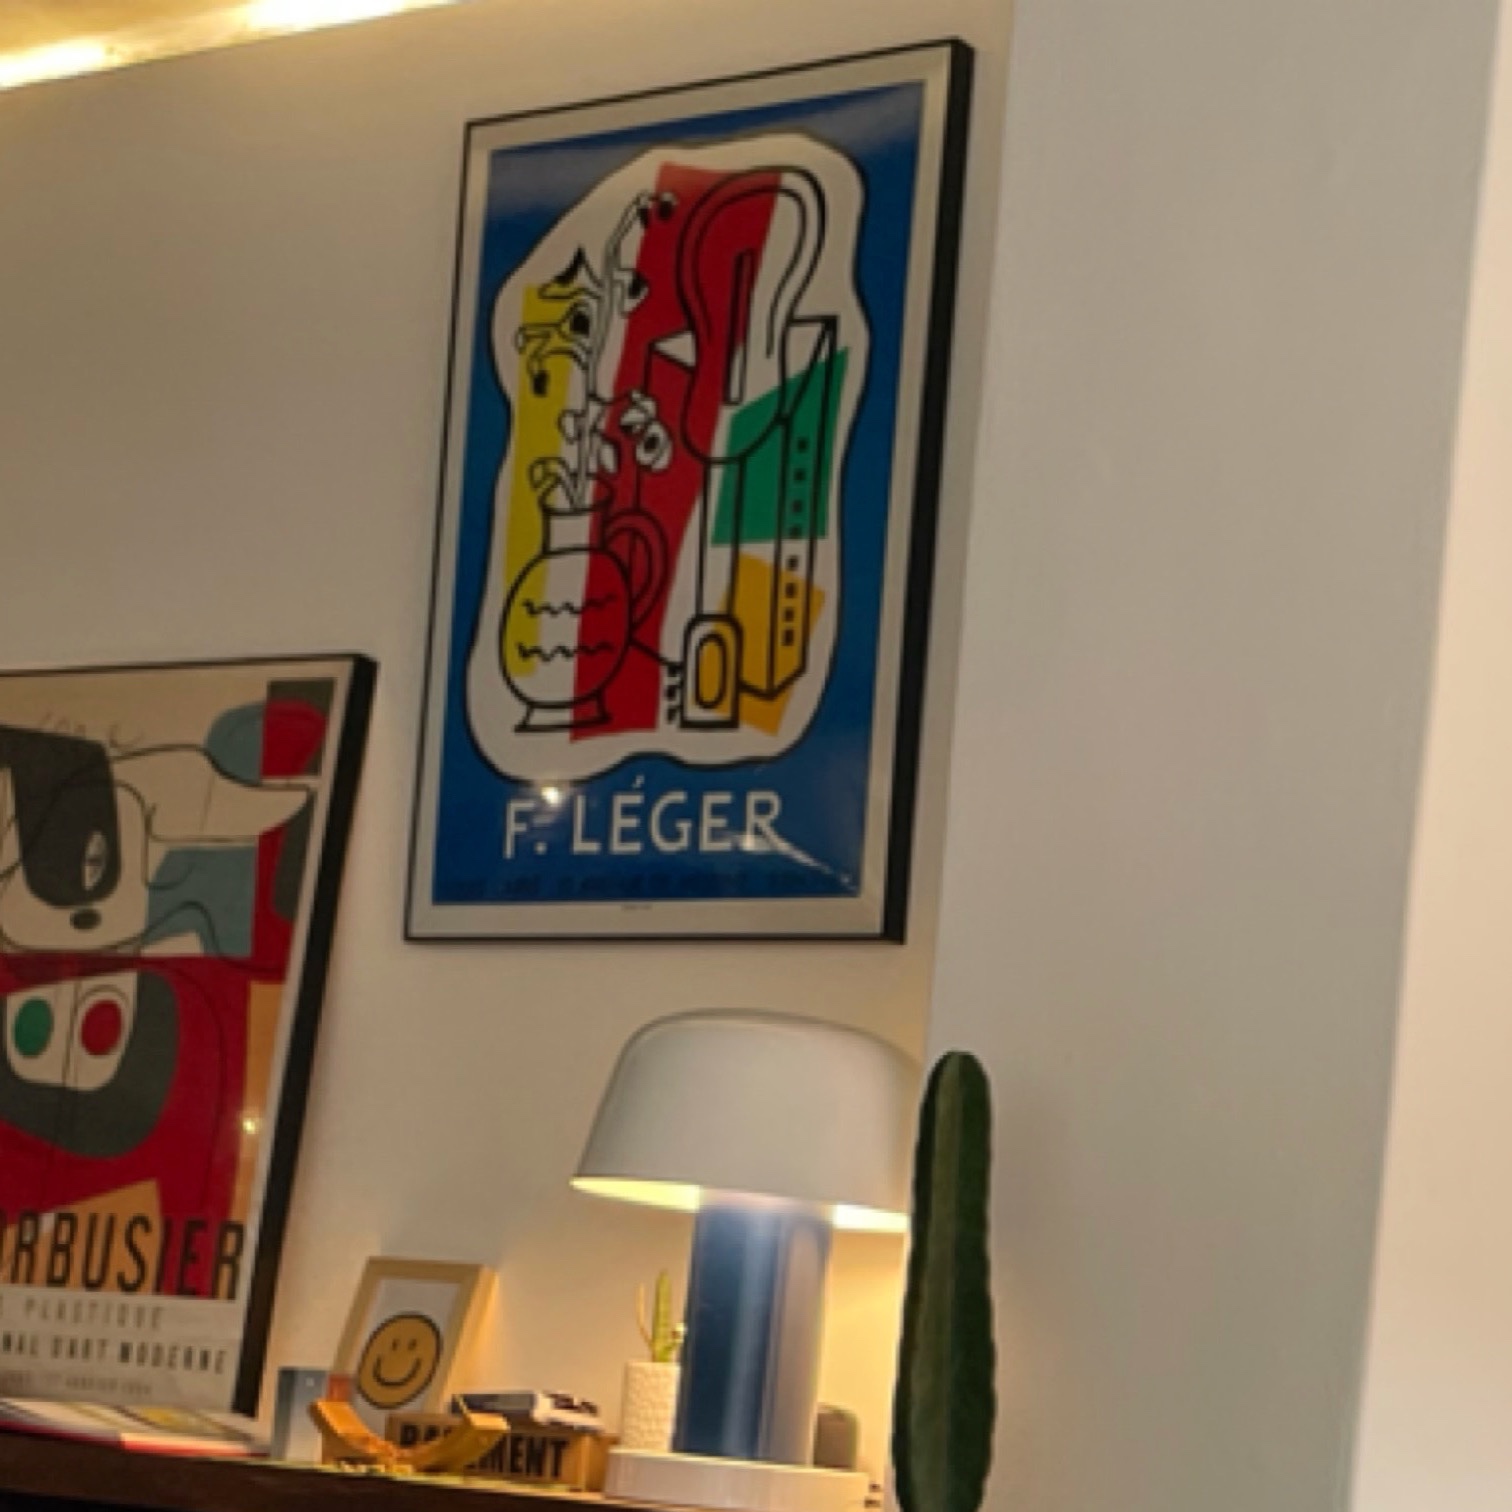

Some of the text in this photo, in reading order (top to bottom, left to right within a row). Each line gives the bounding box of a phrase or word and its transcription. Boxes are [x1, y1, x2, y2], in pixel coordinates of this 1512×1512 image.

[571, 775, 783, 856] LÉGER
[24, 1298, 164, 1329] PLASTIQUE
[119, 1342, 228, 1375] MODERNE
